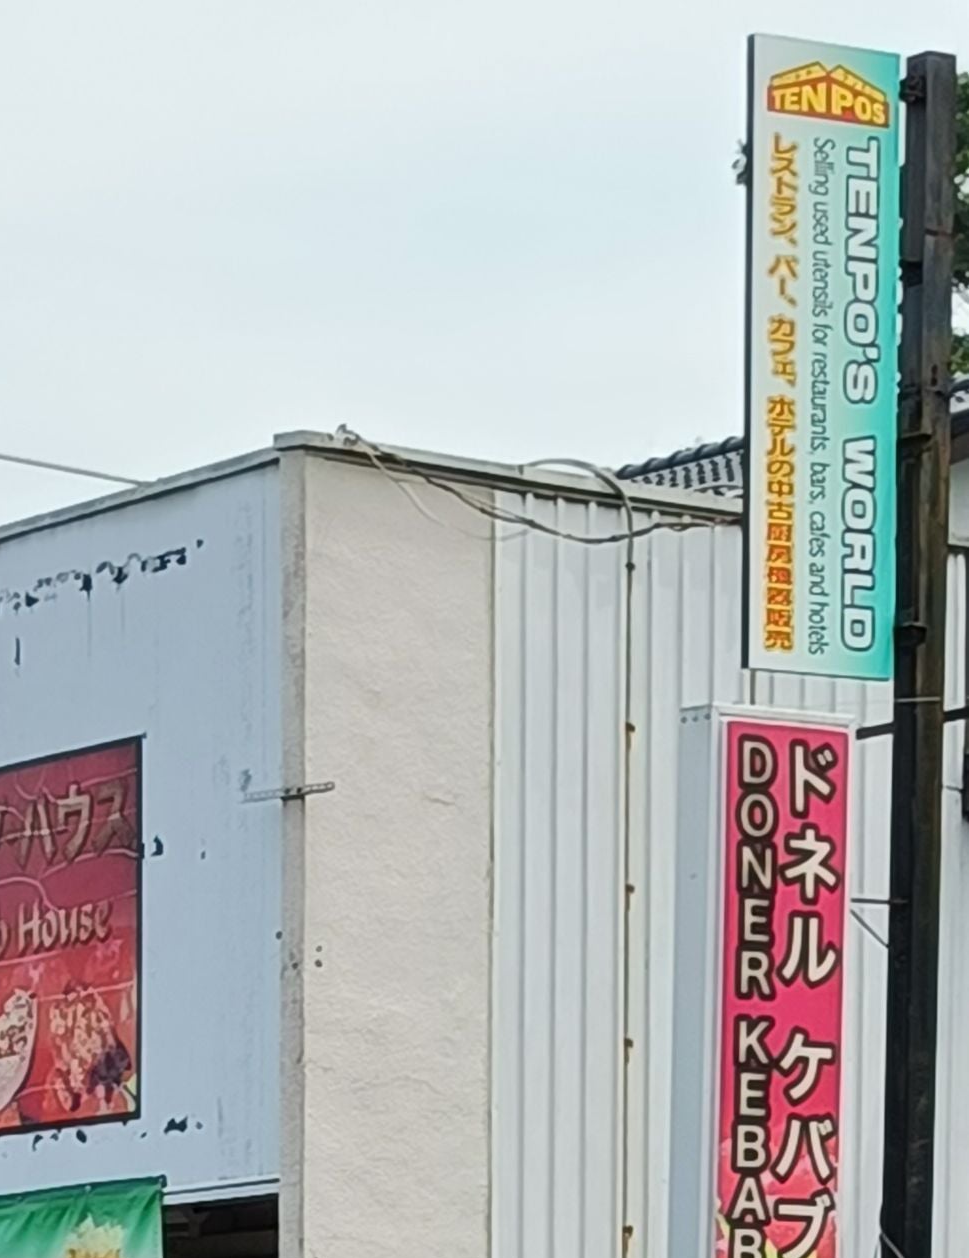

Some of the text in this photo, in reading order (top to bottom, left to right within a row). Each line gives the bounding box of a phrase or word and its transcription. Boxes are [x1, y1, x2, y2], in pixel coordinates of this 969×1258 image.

[772, 82, 886, 125] TENPOS
[809, 138, 835, 196] Selling
[812, 202, 834, 246] used
[811, 251, 835, 317] utensils
[843, 135, 880, 404] TENPO'S
[811, 321, 834, 346] for
[807, 511, 829, 556] cafes
[840, 435, 877, 652] WORLD
[808, 563, 829, 596] and
[808, 601, 830, 655] hotels
[738, 738, 776, 998] DONER
[779, 741, 838, 985] ドネル
[17, 897, 112, 953] House
